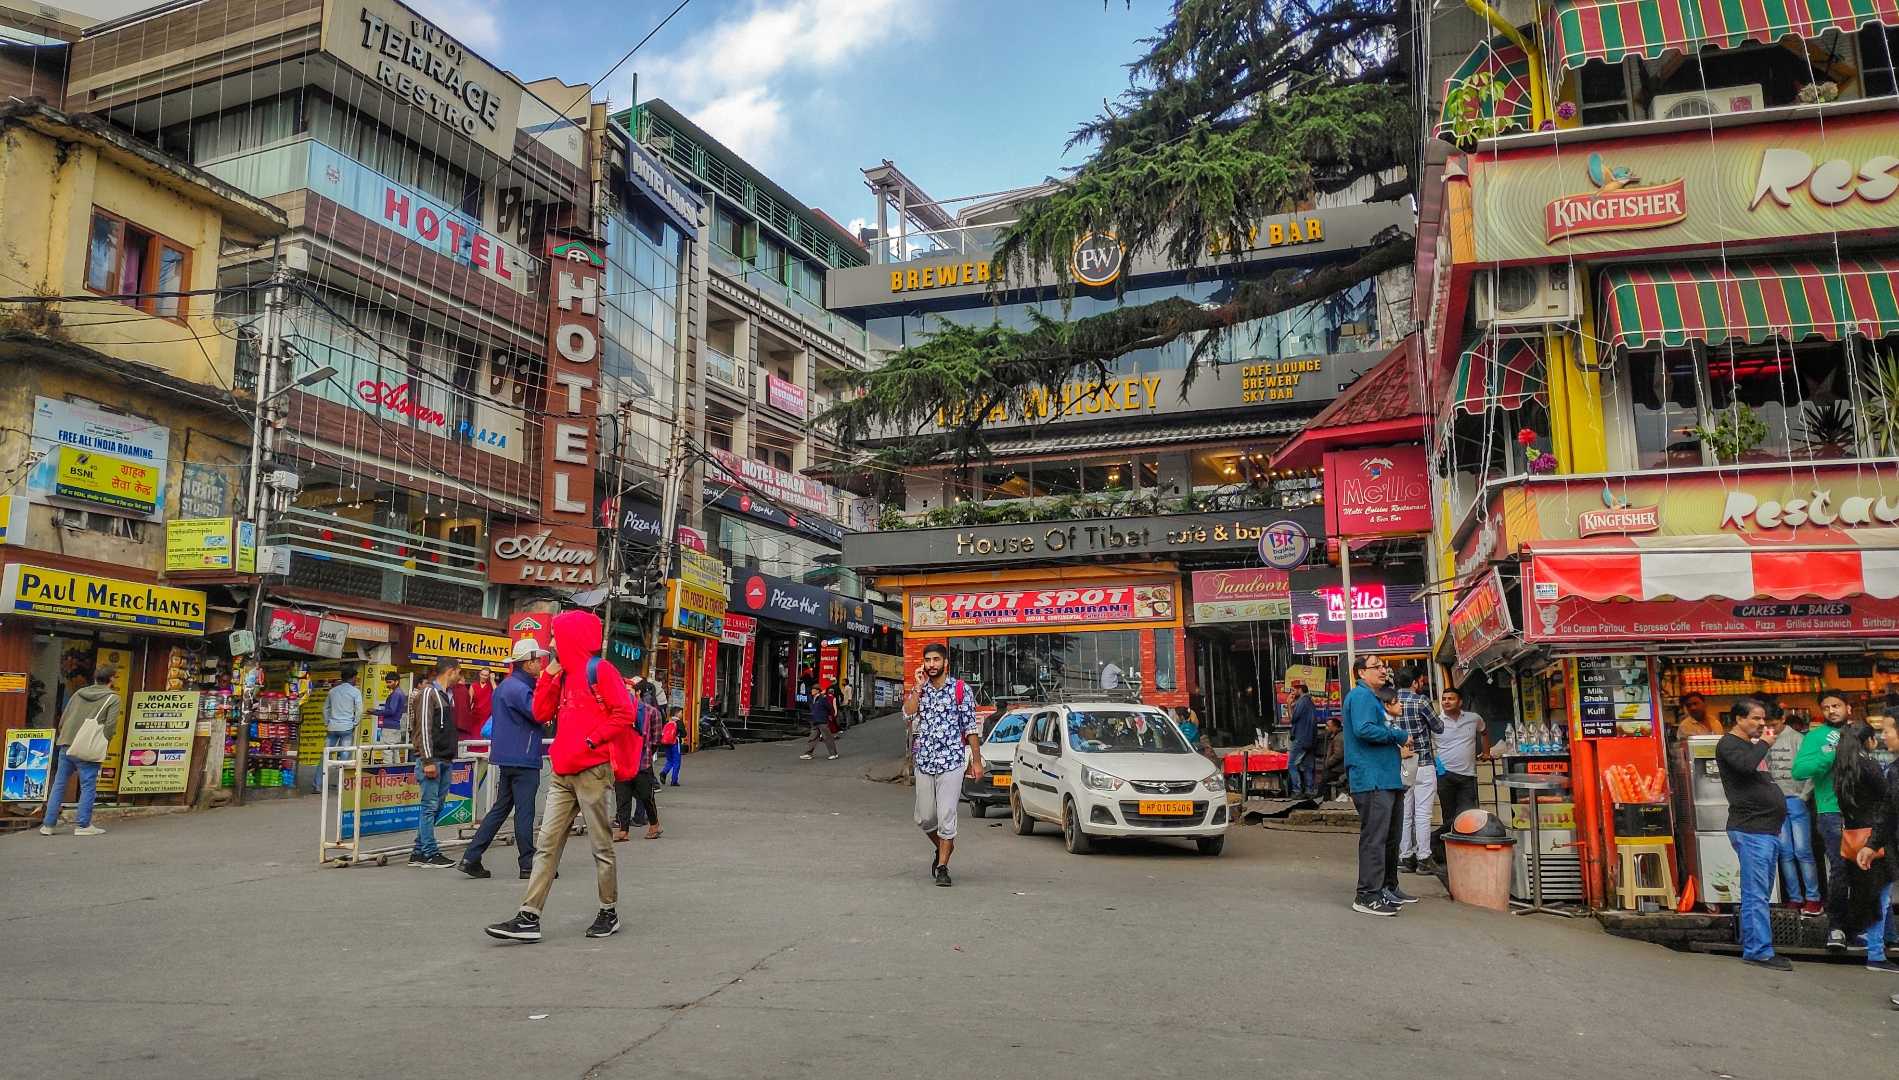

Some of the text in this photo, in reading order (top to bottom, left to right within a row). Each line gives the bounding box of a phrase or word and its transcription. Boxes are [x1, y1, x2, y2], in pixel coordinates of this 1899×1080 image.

[409, 19, 467, 66] ENJOY
[361, 8, 502, 132] TERRACE
[377, 60, 479, 136] RESTRO
[1552, 190, 1684, 228] KINGFISHER
[384, 187, 512, 280] HOTEL
[1269, 218, 1322, 247] BAR
[890, 260, 1005, 293] BREWER
[1552, 281, 1568, 291] LG
[1242, 360, 1321, 377] CAFE LOUNGE
[556, 271, 598, 514] HOTEL
[1242, 375, 1299, 390] BREWERY
[357, 379, 446, 428] Asian
[1243, 387, 1294, 402] SKY BAR
[58, 429, 77, 443] FREE
[79, 434, 93, 446] ALL
[94, 437, 116, 451] INDIA
[118, 442, 153, 459] ROAMING
[460, 420, 508, 449] PLAZA
[624, 511, 650, 532] Pizza
[1583, 510, 1657, 531] KINGFISHER
[495, 529, 596, 566] Asian
[957, 532, 1035, 555] House
[1044, 525, 1078, 552] Of
[1084, 523, 1149, 549] Tibet
[1213, 523, 1229, 542] &
[520, 563, 594, 585] PLAZA
[770, 588, 820, 615] Pizza Hut
[951, 588, 1129, 610] HOT SPOT
[1742, 605, 1776, 616] CAKES
[1808, 604, 1844, 615] BAKES
[950, 611, 960, 619] A
[964, 608, 1019, 618] FAMILY
[1024, 604, 1129, 616] RESTAURANT
[1330, 610, 1384, 620] Resaurant
[1561, 624, 1571, 633] Ice
[1573, 624, 1598, 633] Cream
[1599, 623, 1626, 633] Parlour
[1633, 622, 1669, 633] Espresso
[1701, 621, 1722, 631] Fresh
[1725, 621, 1744, 631] Juice
[1755, 620, 1776, 630] Pizza
[1786, 619, 1811, 629] Grilled
[1814, 618, 1852, 628] Sandwich
[1862, 617, 1896, 628] Birthday
[1583, 674, 1606, 682] Lassi
[147, 694, 185, 702] MONEY
[1587, 687, 1604, 695] Milk
[1587, 707, 1606, 715] Kulfi
